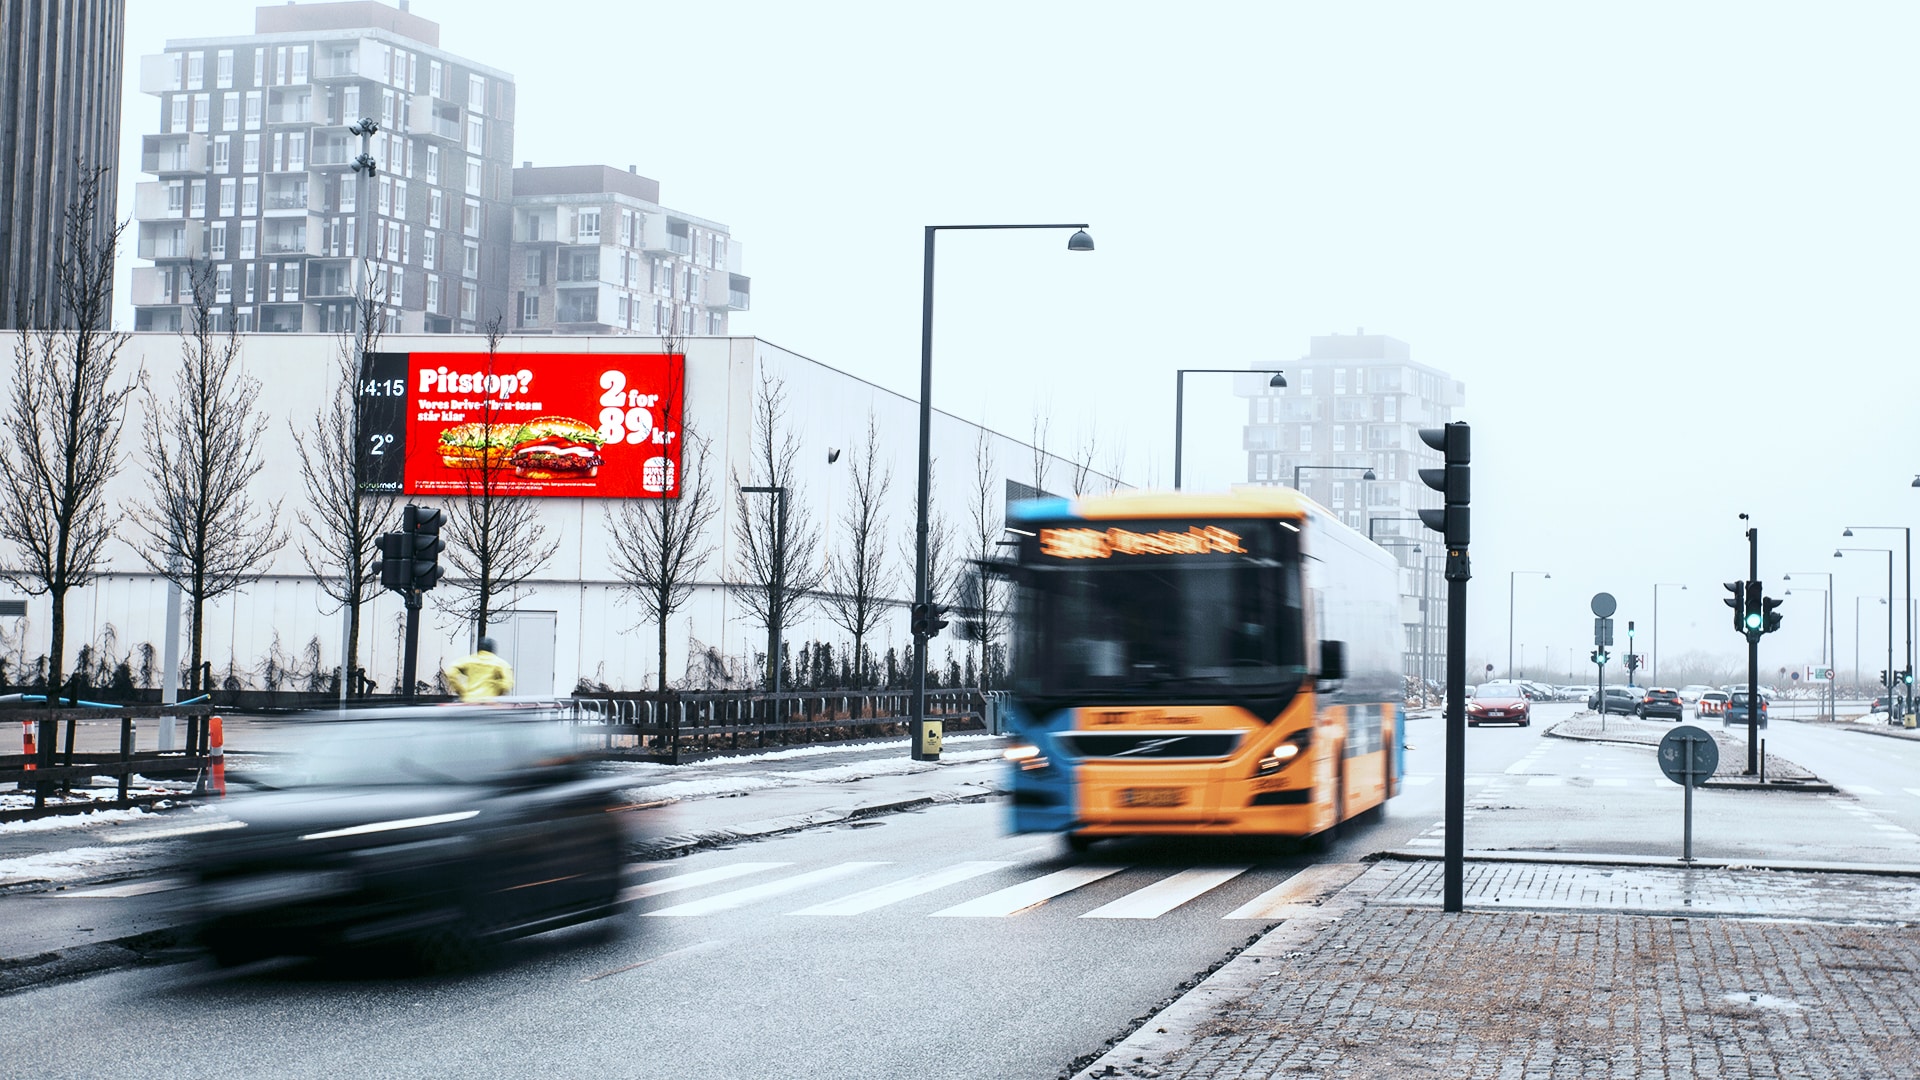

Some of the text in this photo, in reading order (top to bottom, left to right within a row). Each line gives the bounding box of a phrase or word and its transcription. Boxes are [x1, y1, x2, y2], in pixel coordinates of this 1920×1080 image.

[359, 379, 405, 397] 14:15
[418, 365, 533, 399] Pitstop?
[599, 370, 659, 408] 2 for
[417, 410, 465, 421] står klar
[418, 399, 449, 410] Vores
[596, 406, 676, 445] 89 kr
[370, 433, 394, 455] 2°
